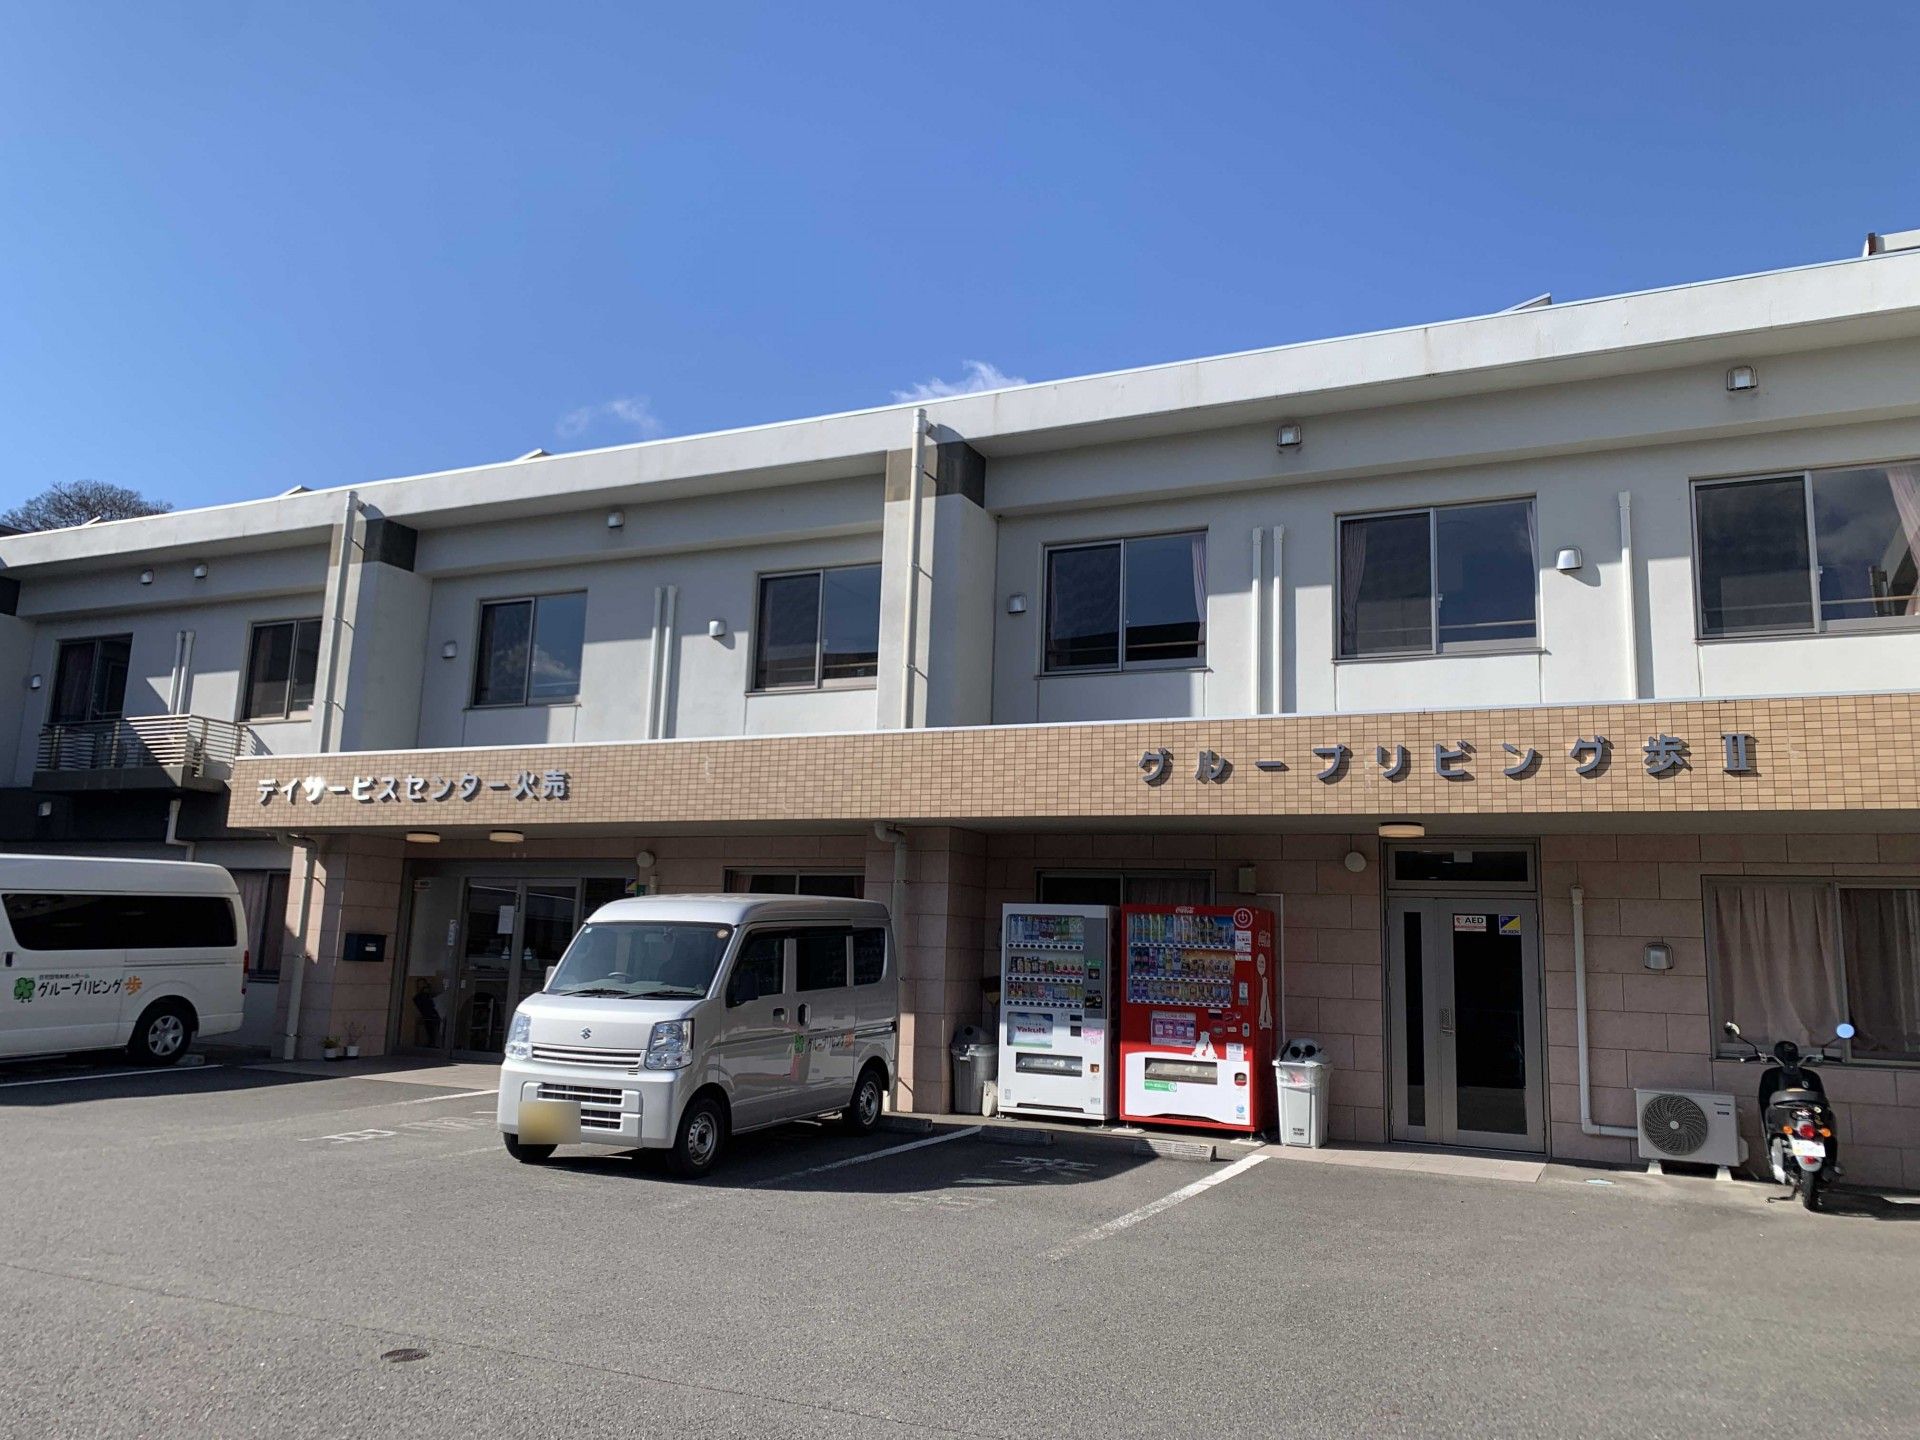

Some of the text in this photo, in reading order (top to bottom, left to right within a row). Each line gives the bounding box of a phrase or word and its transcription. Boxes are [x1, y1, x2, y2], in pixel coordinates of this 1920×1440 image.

[257, 768, 569, 804] デイサービスセンター火売
[1016, 1025, 1047, 1034] Yakult
